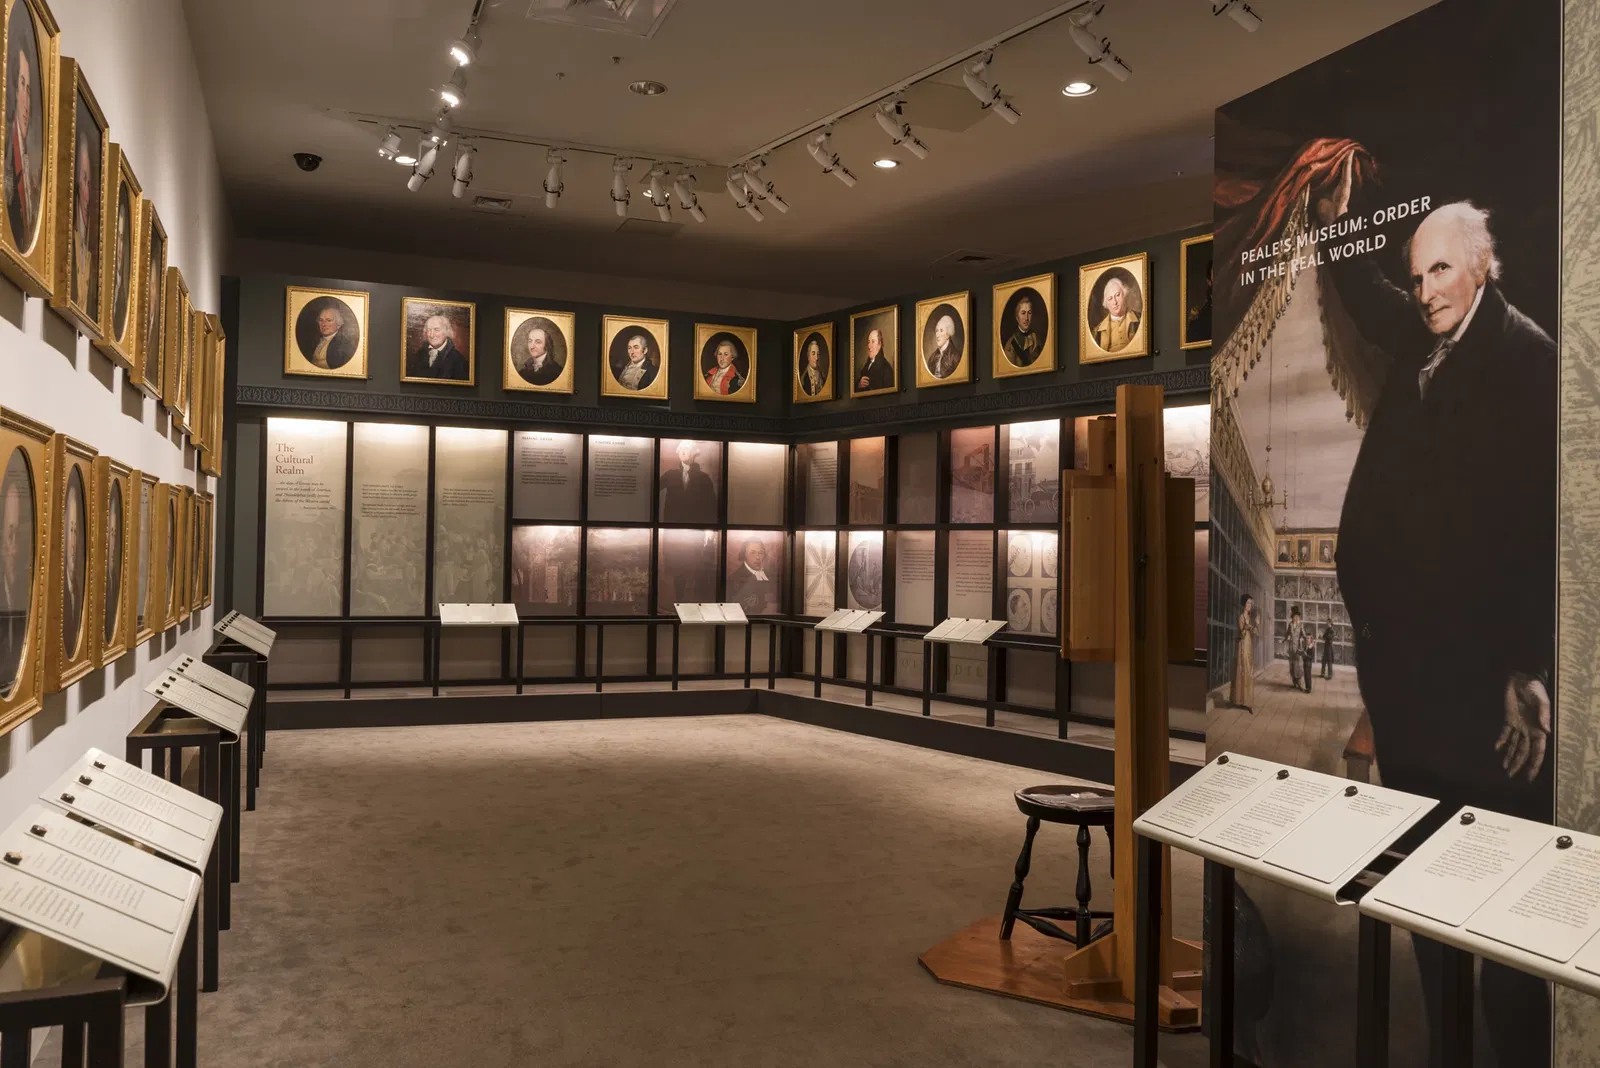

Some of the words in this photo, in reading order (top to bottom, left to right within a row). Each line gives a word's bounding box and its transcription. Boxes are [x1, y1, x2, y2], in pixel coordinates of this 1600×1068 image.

[1241, 237, 1292, 265] PEALE'S
[1296, 215, 1368, 249] MUSEUM:
[1372, 195, 1431, 226] ORDER
[1240, 271, 1255, 286] IN
[1258, 261, 1286, 281] THE
[1291, 251, 1325, 274] REAL
[1328, 233, 1387, 262] WORLD
[276, 443, 295, 453] The
[275, 453, 314, 464] Cultural
[275, 465, 305, 475] Realm
